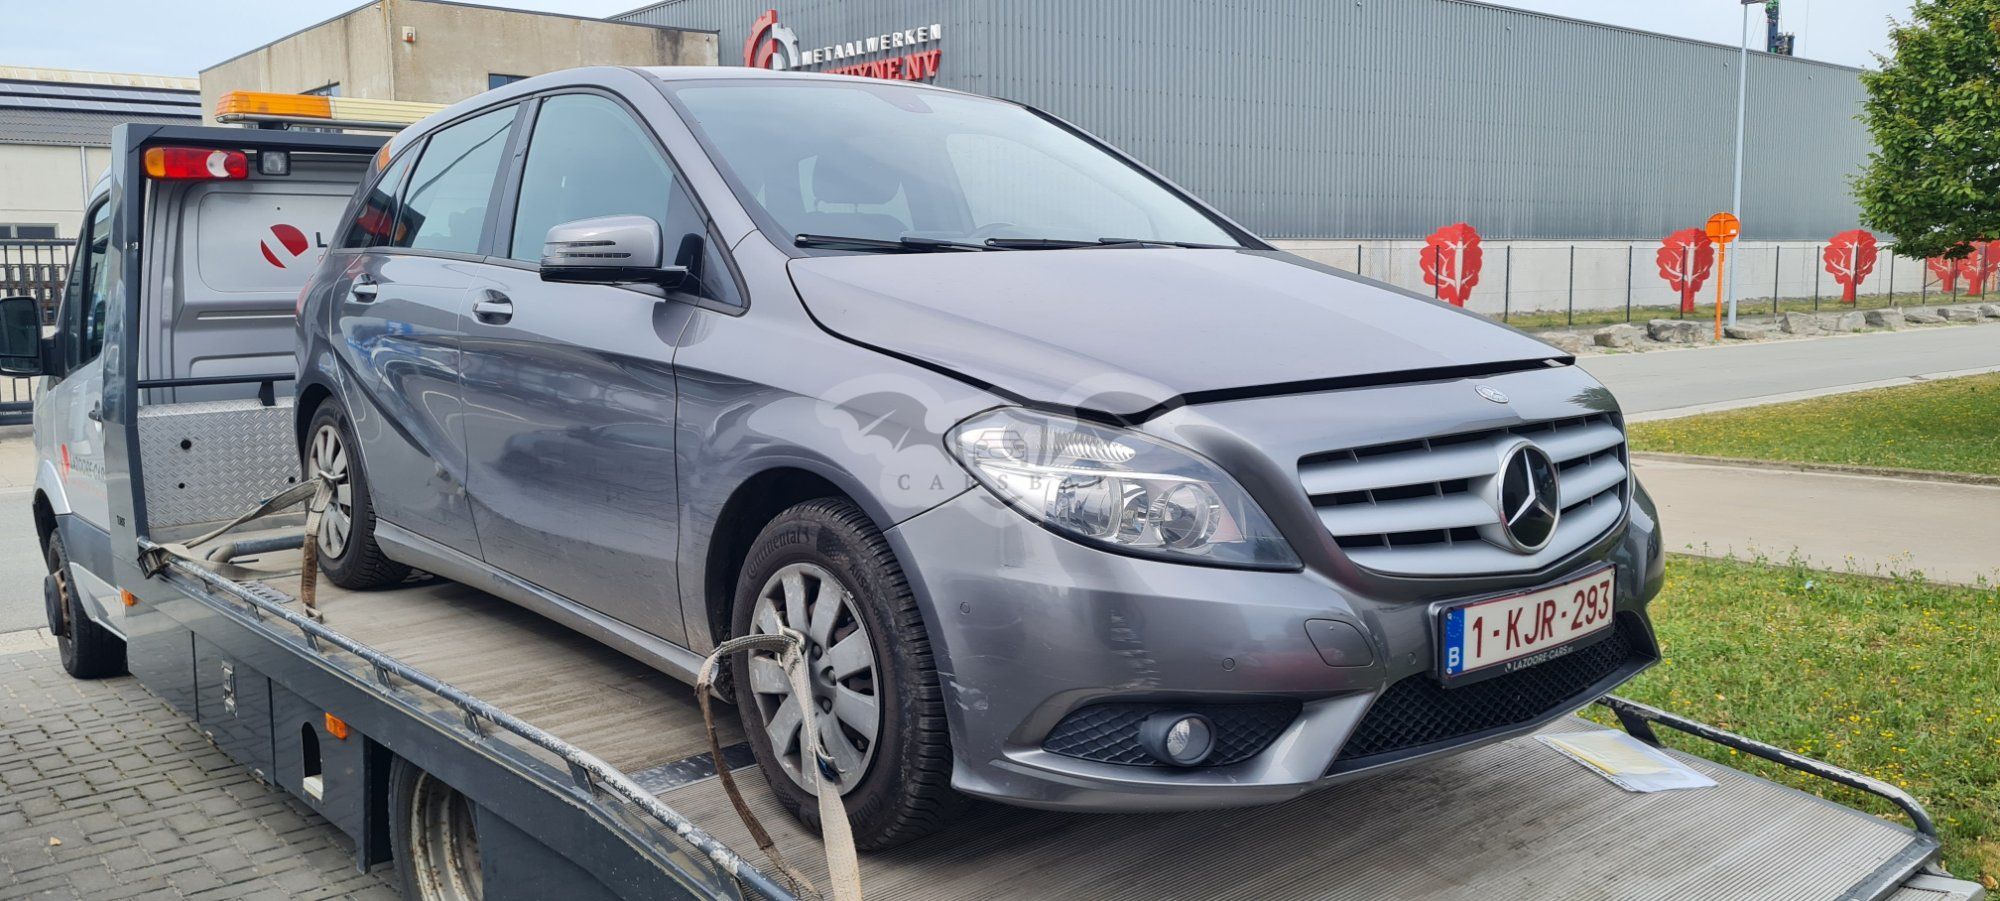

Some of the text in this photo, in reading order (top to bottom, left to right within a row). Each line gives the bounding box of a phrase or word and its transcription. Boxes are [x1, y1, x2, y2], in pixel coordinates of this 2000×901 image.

[801, 23, 942, 66] METAALWERKEN
[905, 48, 942, 81] NV
[1472, 579, 1610, 659] 1-KJR-293
[1448, 646, 1460, 668] B
